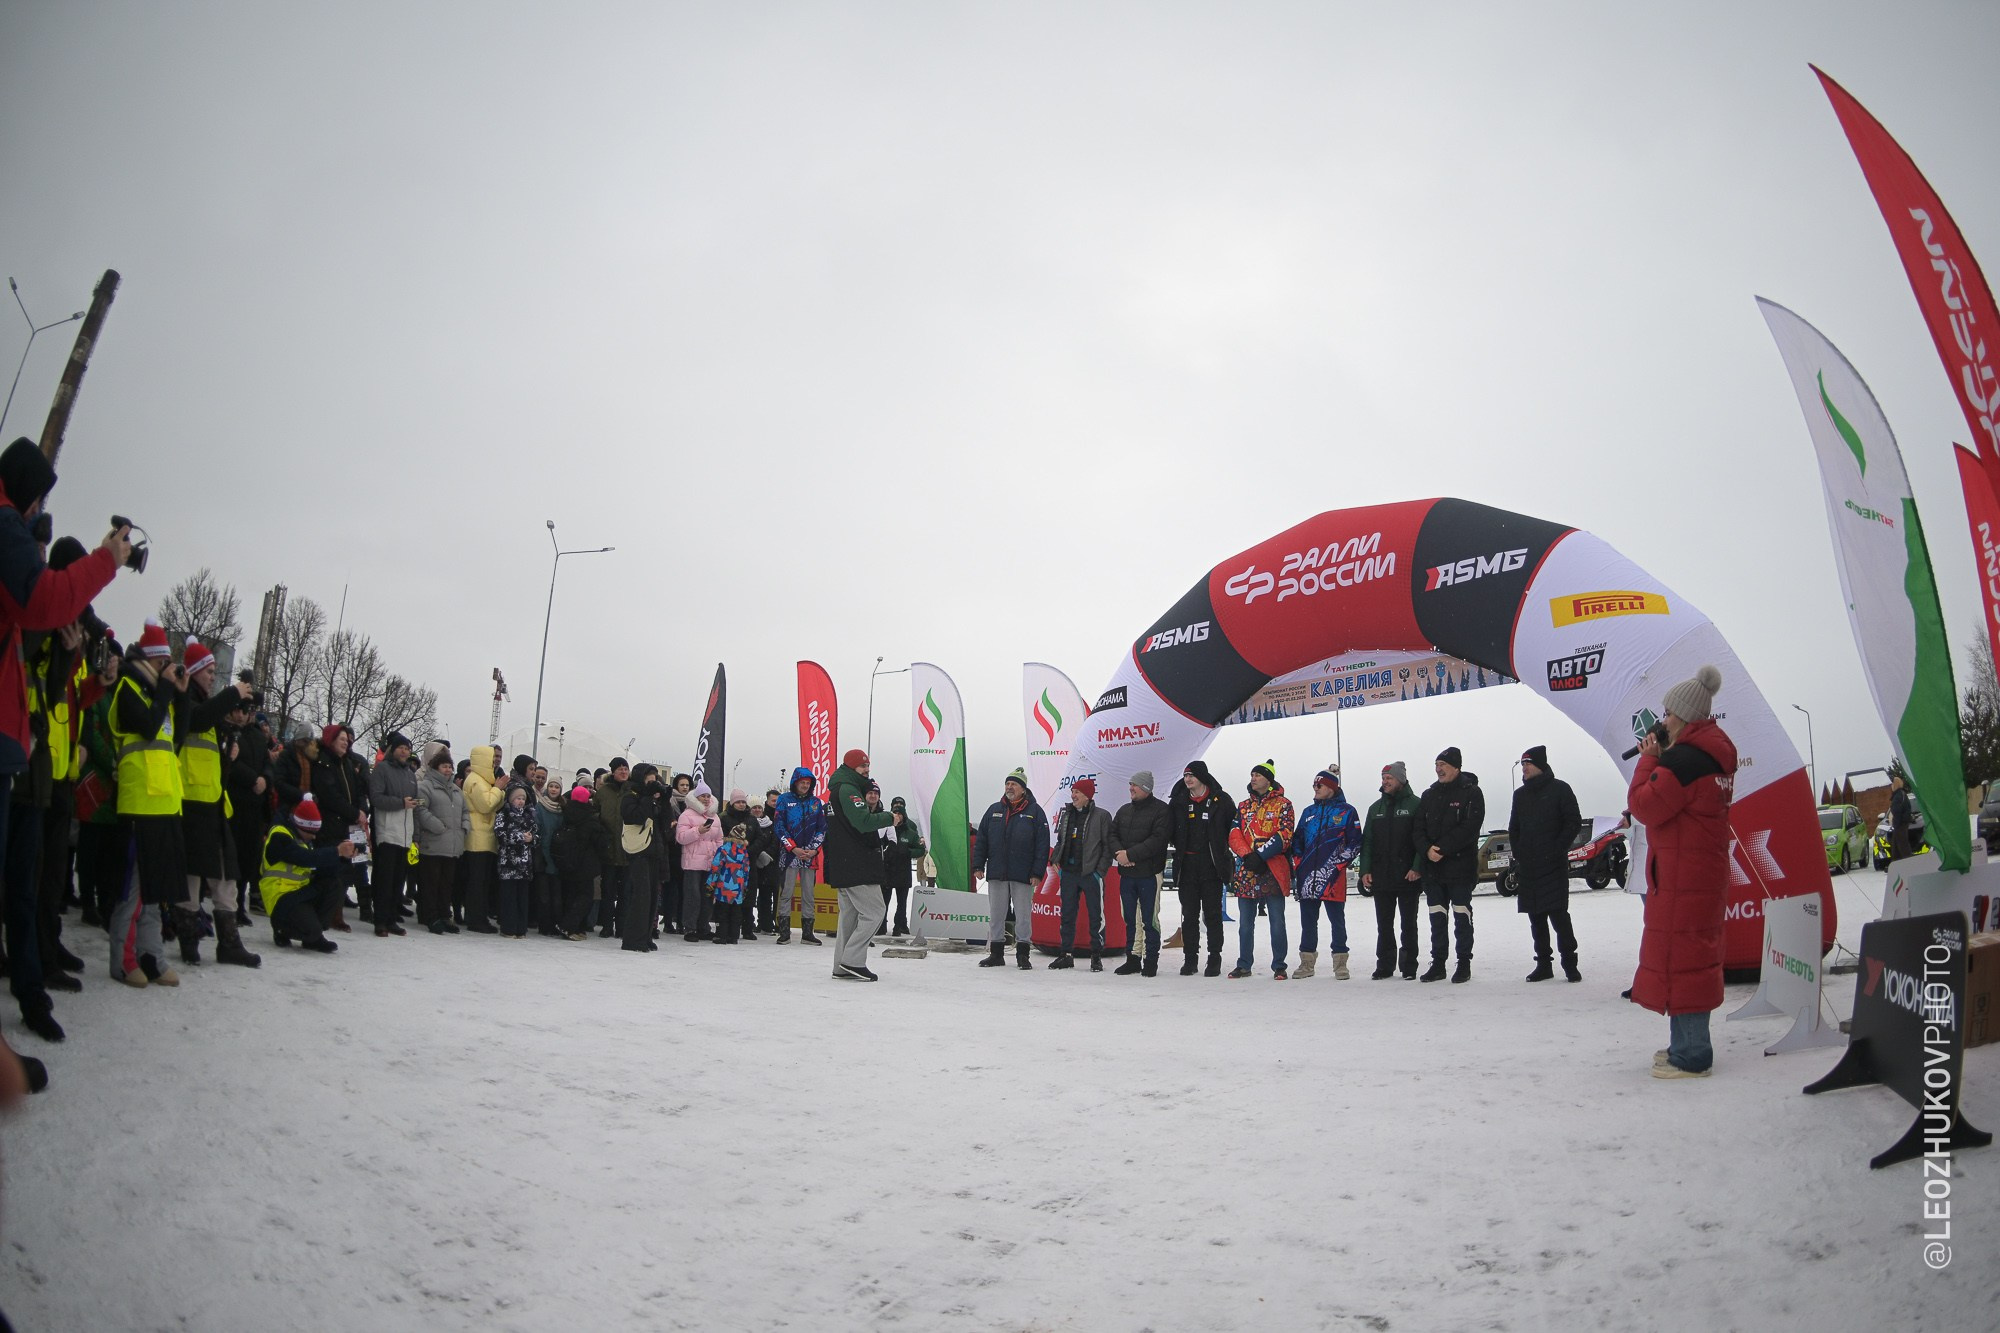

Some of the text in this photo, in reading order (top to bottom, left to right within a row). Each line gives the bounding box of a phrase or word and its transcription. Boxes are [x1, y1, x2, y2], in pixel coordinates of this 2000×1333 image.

[1280, 531, 1382, 577] РАЛЛИ
[1277, 551, 1396, 603] РОССИИ
[1425, 548, 1528, 592] ASMG
[1572, 594, 1645, 618] PIRELLI
[1141, 620, 1210, 654] ASMG
[1574, 641, 1608, 655] ТЕЛЕКАНАЛ
[1331, 660, 1377, 674] ТАТНЕФТЬ
[1549, 653, 1601, 679] АВТО
[1310, 669, 1393, 699] КАРЕЛИЯ
[1550, 675, 1584, 690] ПЛЮС
[1337, 693, 1366, 710] 2026
[1771, 949, 1815, 984] ТАТНЕФТЬ
